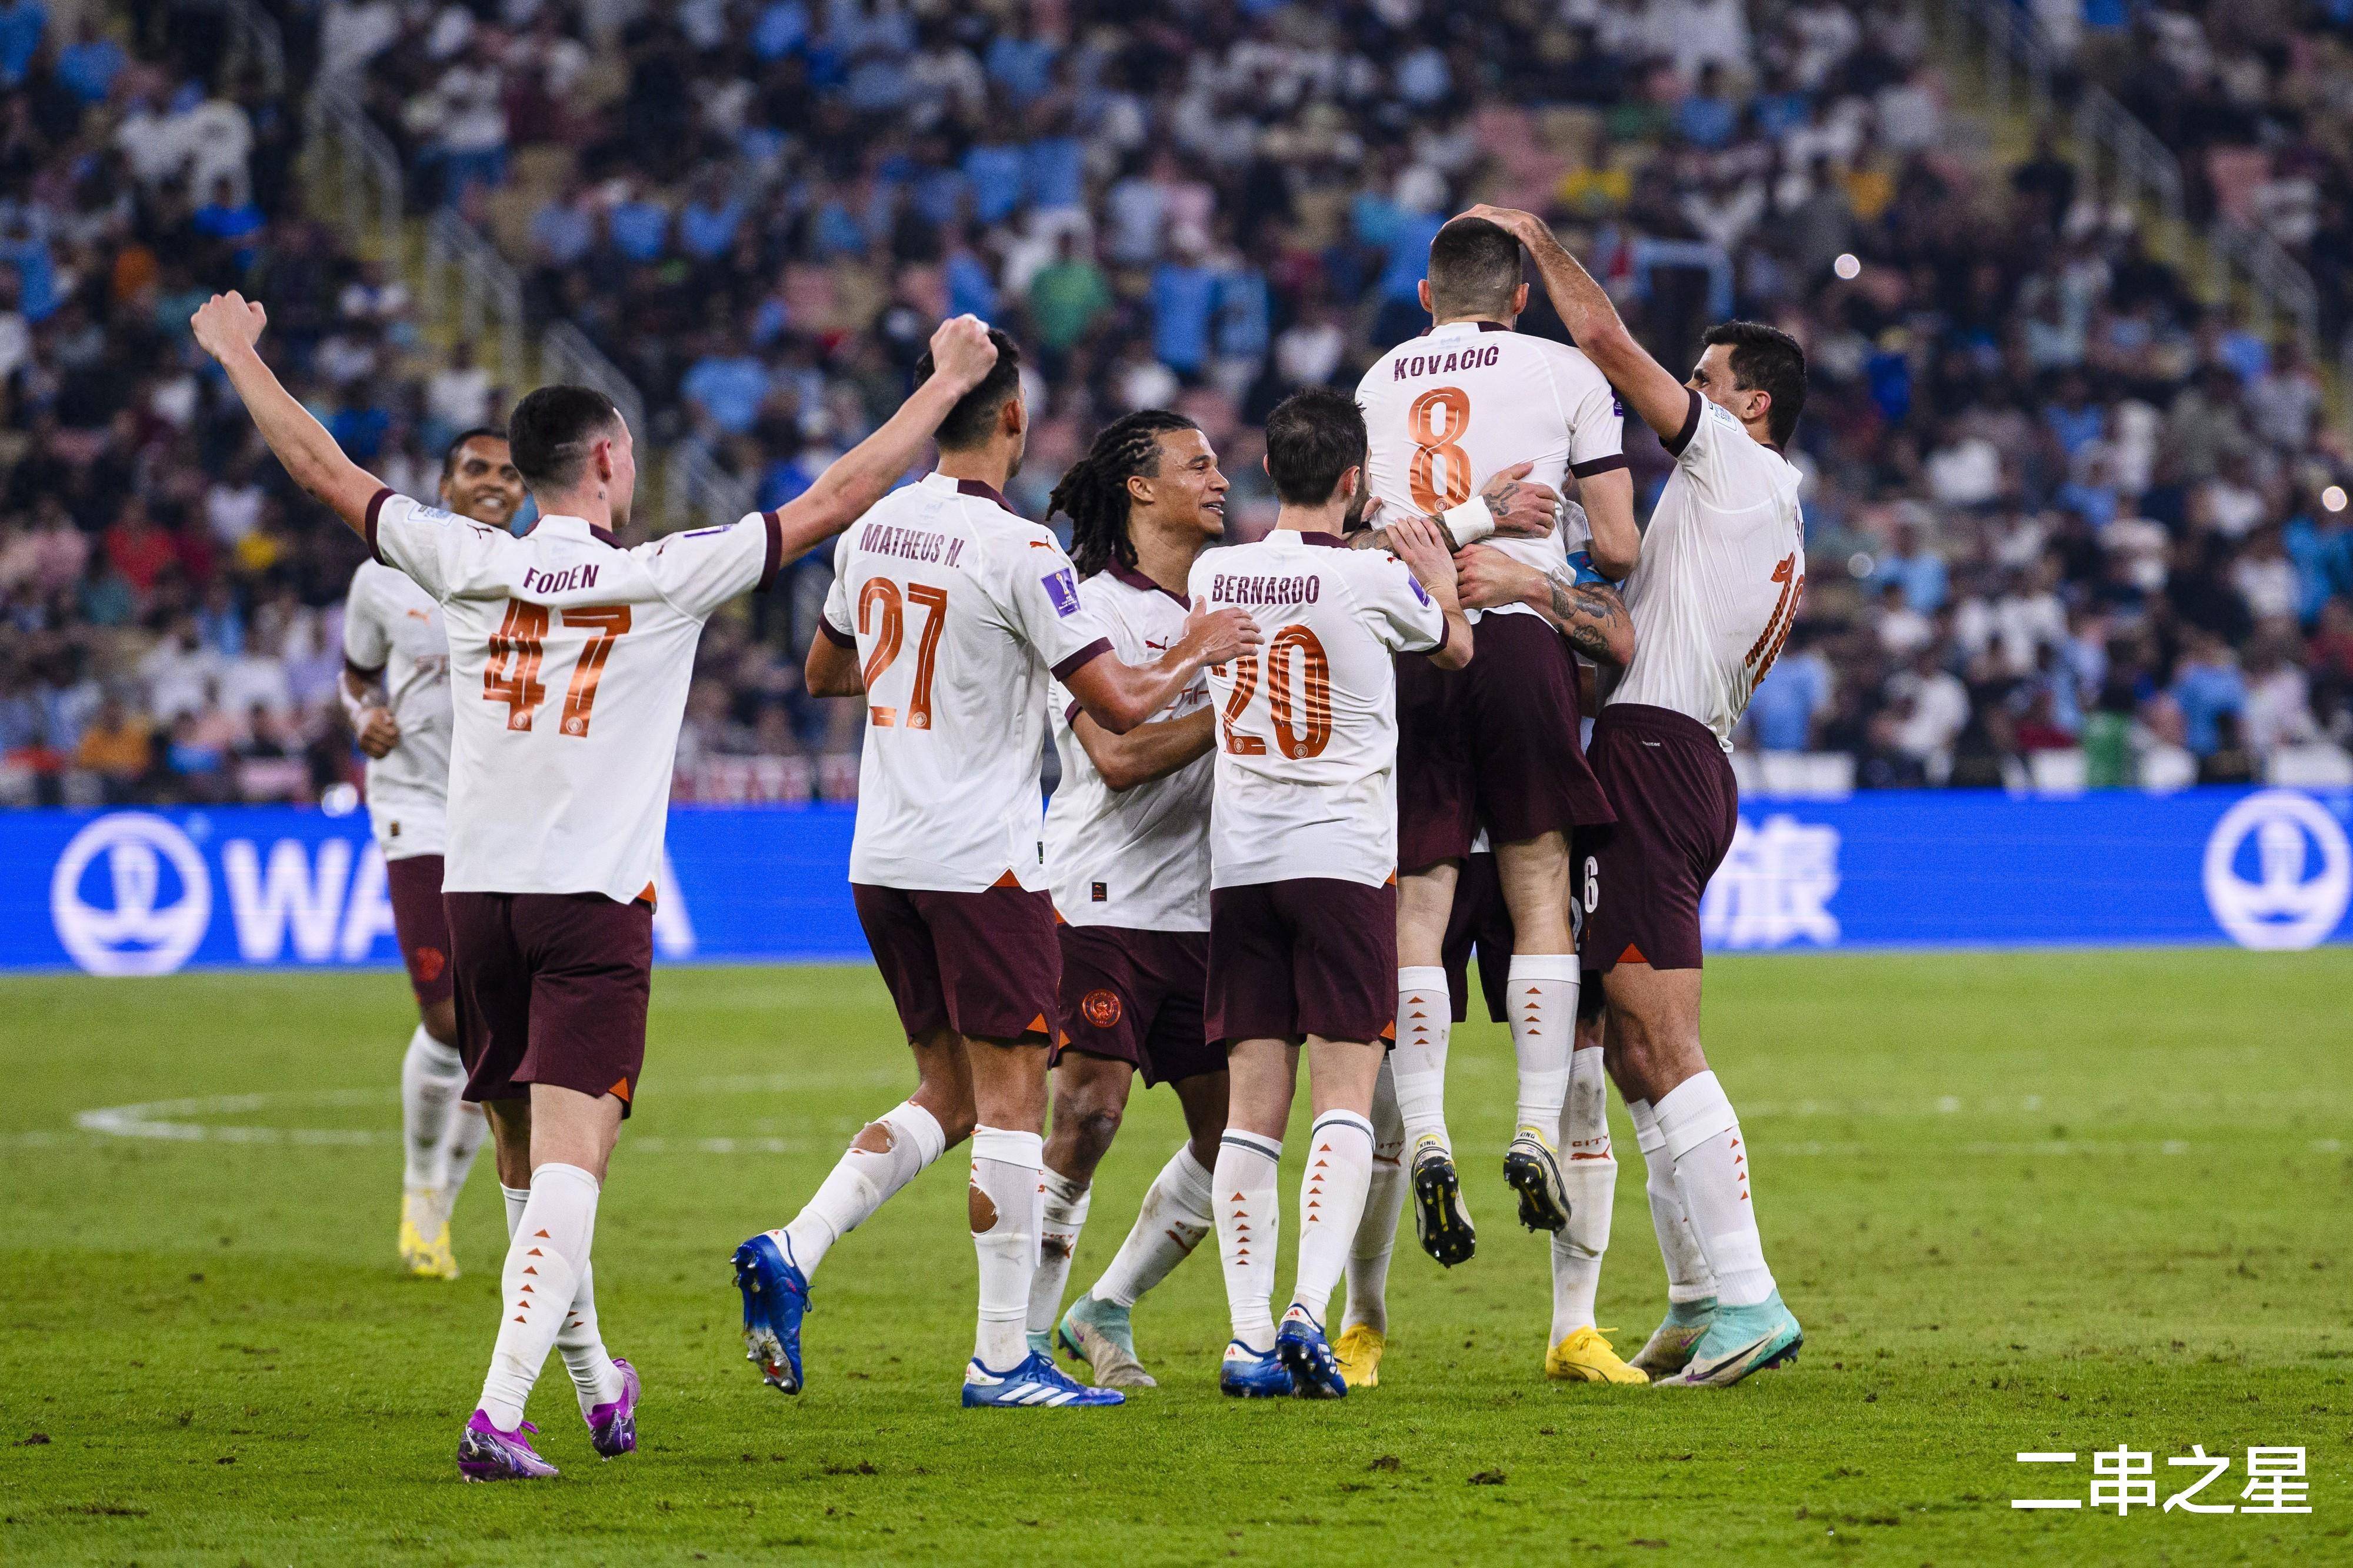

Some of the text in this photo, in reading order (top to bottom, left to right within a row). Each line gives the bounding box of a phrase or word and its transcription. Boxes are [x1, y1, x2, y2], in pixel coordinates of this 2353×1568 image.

[1408, 386, 1471, 515] 8
[523, 565, 599, 593] FODEN
[859, 523, 965, 568] MATHEUS N.
[1212, 574, 1319, 604] BERNARDO
[483, 598, 631, 738] 47
[858, 577, 947, 730] 27
[1211, 624, 1331, 760] 20
[1419, 1140, 1436, 1148] KING
